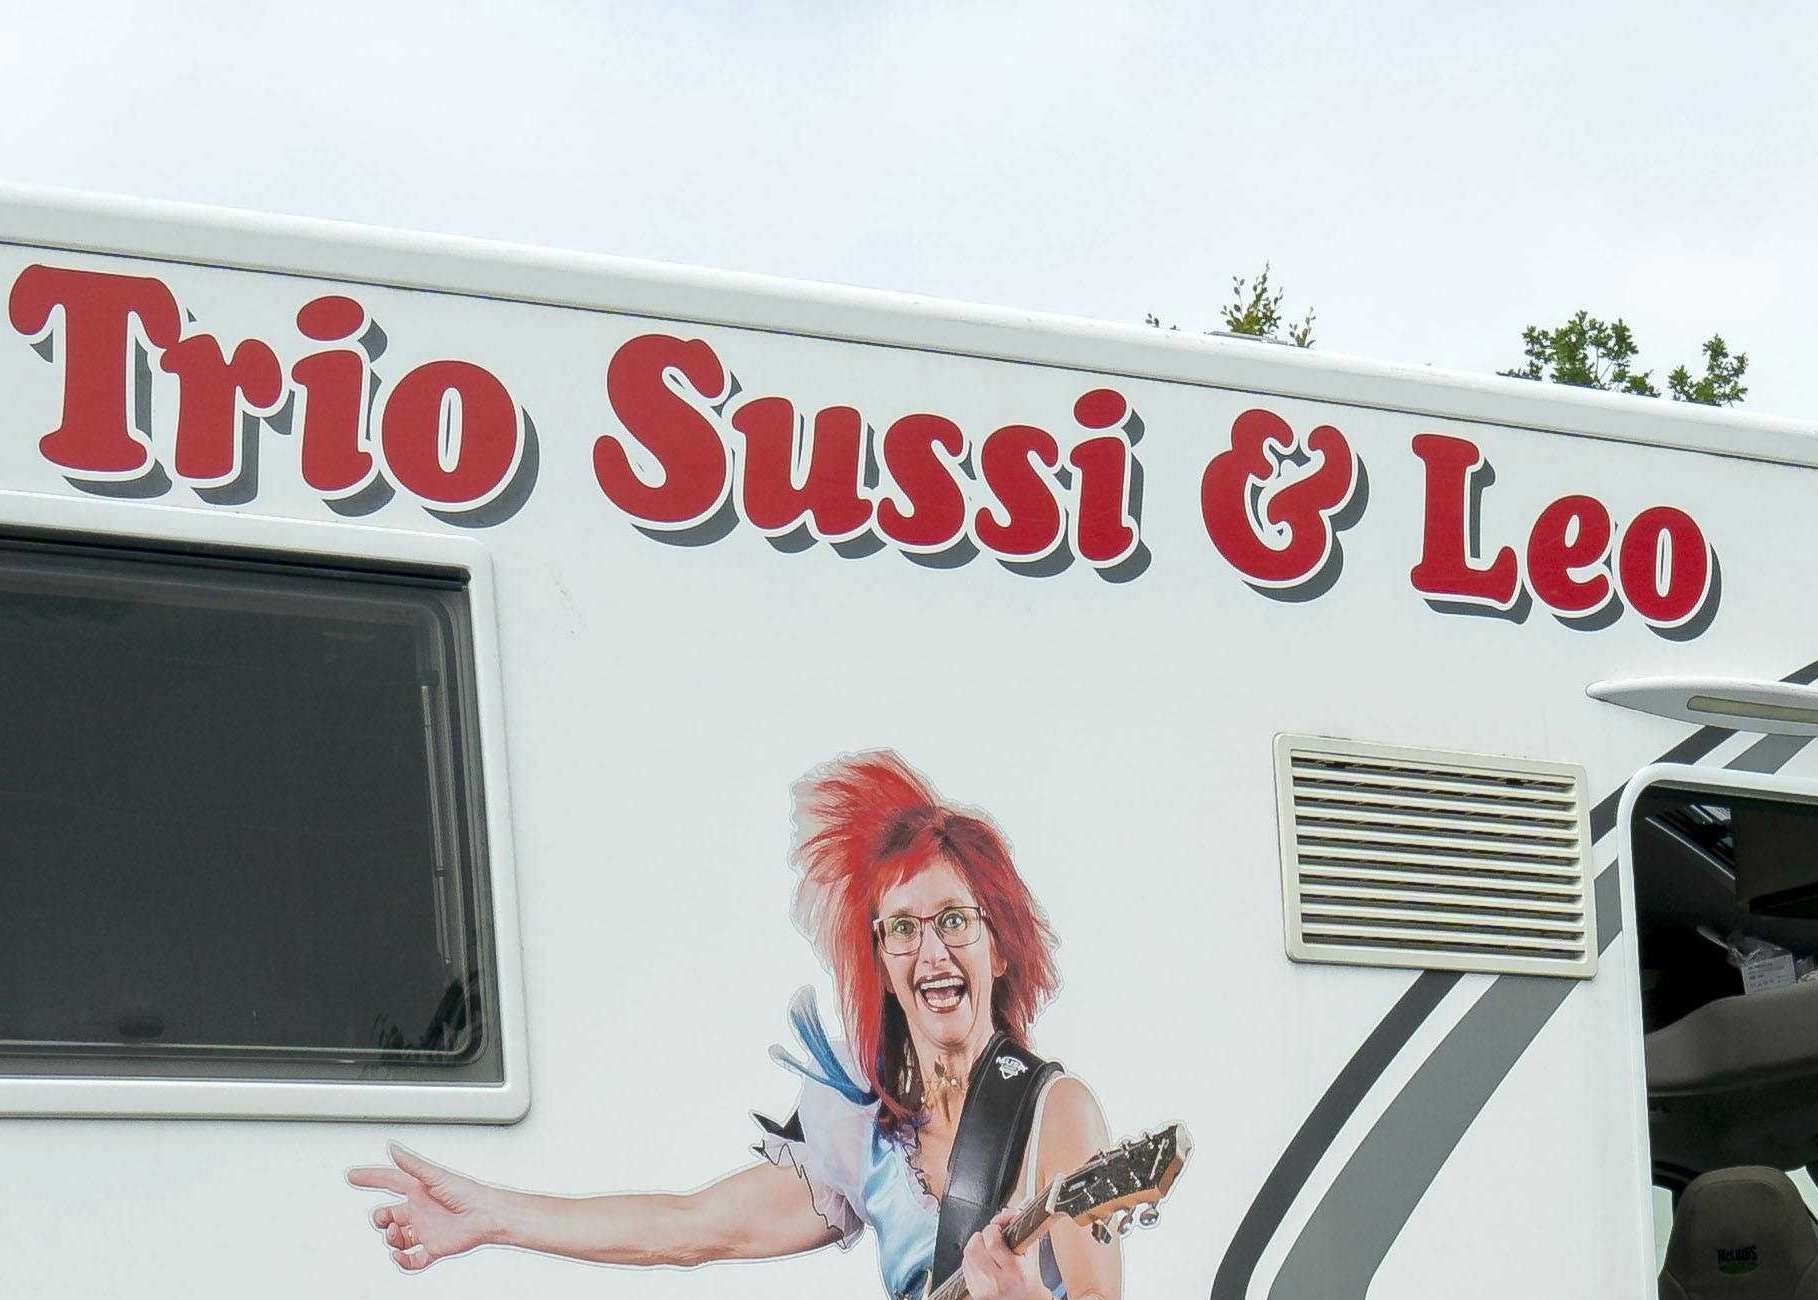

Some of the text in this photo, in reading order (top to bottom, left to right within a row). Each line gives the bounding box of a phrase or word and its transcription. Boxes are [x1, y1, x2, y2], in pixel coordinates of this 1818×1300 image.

[8, 262, 1721, 641] Trio Sussi & Leo
